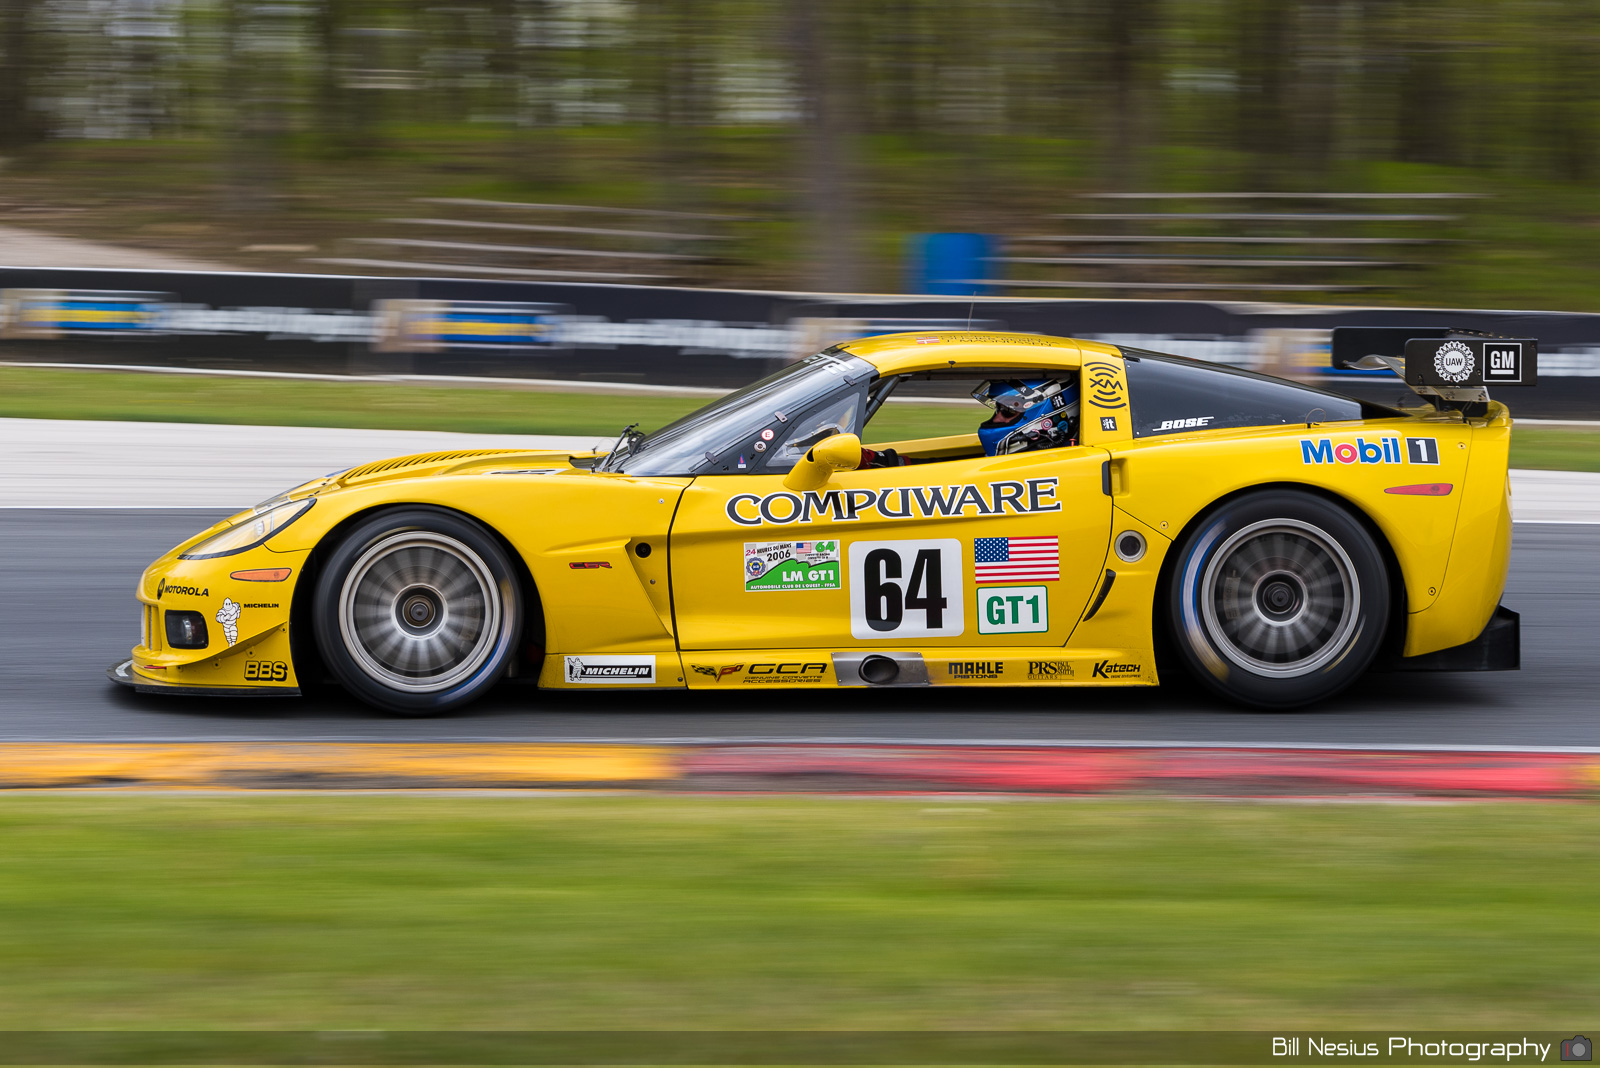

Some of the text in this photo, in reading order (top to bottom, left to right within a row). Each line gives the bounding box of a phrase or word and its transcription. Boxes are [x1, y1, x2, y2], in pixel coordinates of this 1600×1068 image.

[1446, 358, 1463, 366] UAW
[1490, 351, 1515, 369] GM
[1089, 378, 1123, 391] XM
[1153, 416, 1214, 431] BOSE
[1300, 437, 1402, 464] Mobil
[726, 477, 1063, 526] COMPUWARE
[757, 546, 773, 554] HEURES
[815, 541, 835, 552] 64
[767, 550, 791, 562] 2006
[782, 569, 835, 582] LM GT1
[164, 585, 209, 597] MOTOROLA
[864, 548, 948, 632] 64
[986, 594, 1040, 626] GT1
[244, 661, 288, 681] BBS
[585, 667, 649, 675] MICHELIN
[748, 663, 828, 674] GCA
[948, 662, 1003, 674] MAHLE
[1028, 661, 1058, 675] PRS
